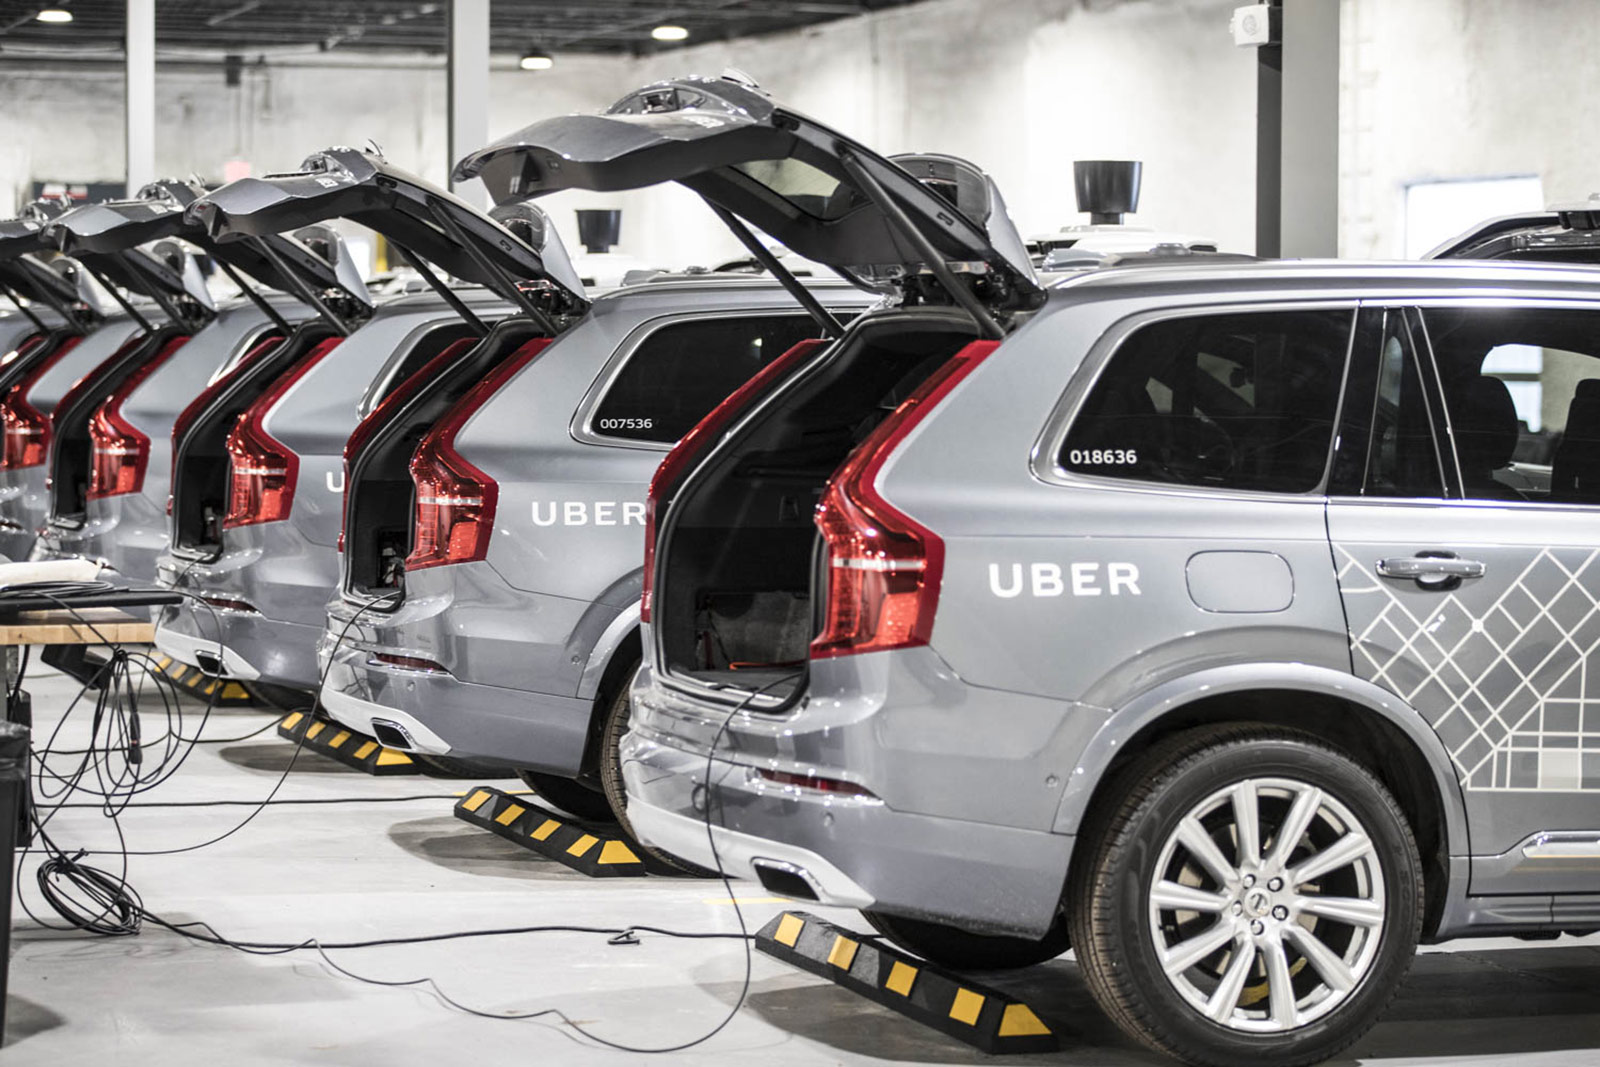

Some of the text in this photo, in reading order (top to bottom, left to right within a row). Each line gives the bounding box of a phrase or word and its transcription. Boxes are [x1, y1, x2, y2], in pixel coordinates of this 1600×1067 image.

[600, 418, 653, 429] 007536
[1070, 449, 1138, 464] 018636
[531, 501, 647, 526] UBER
[988, 562, 1142, 598] UBER
